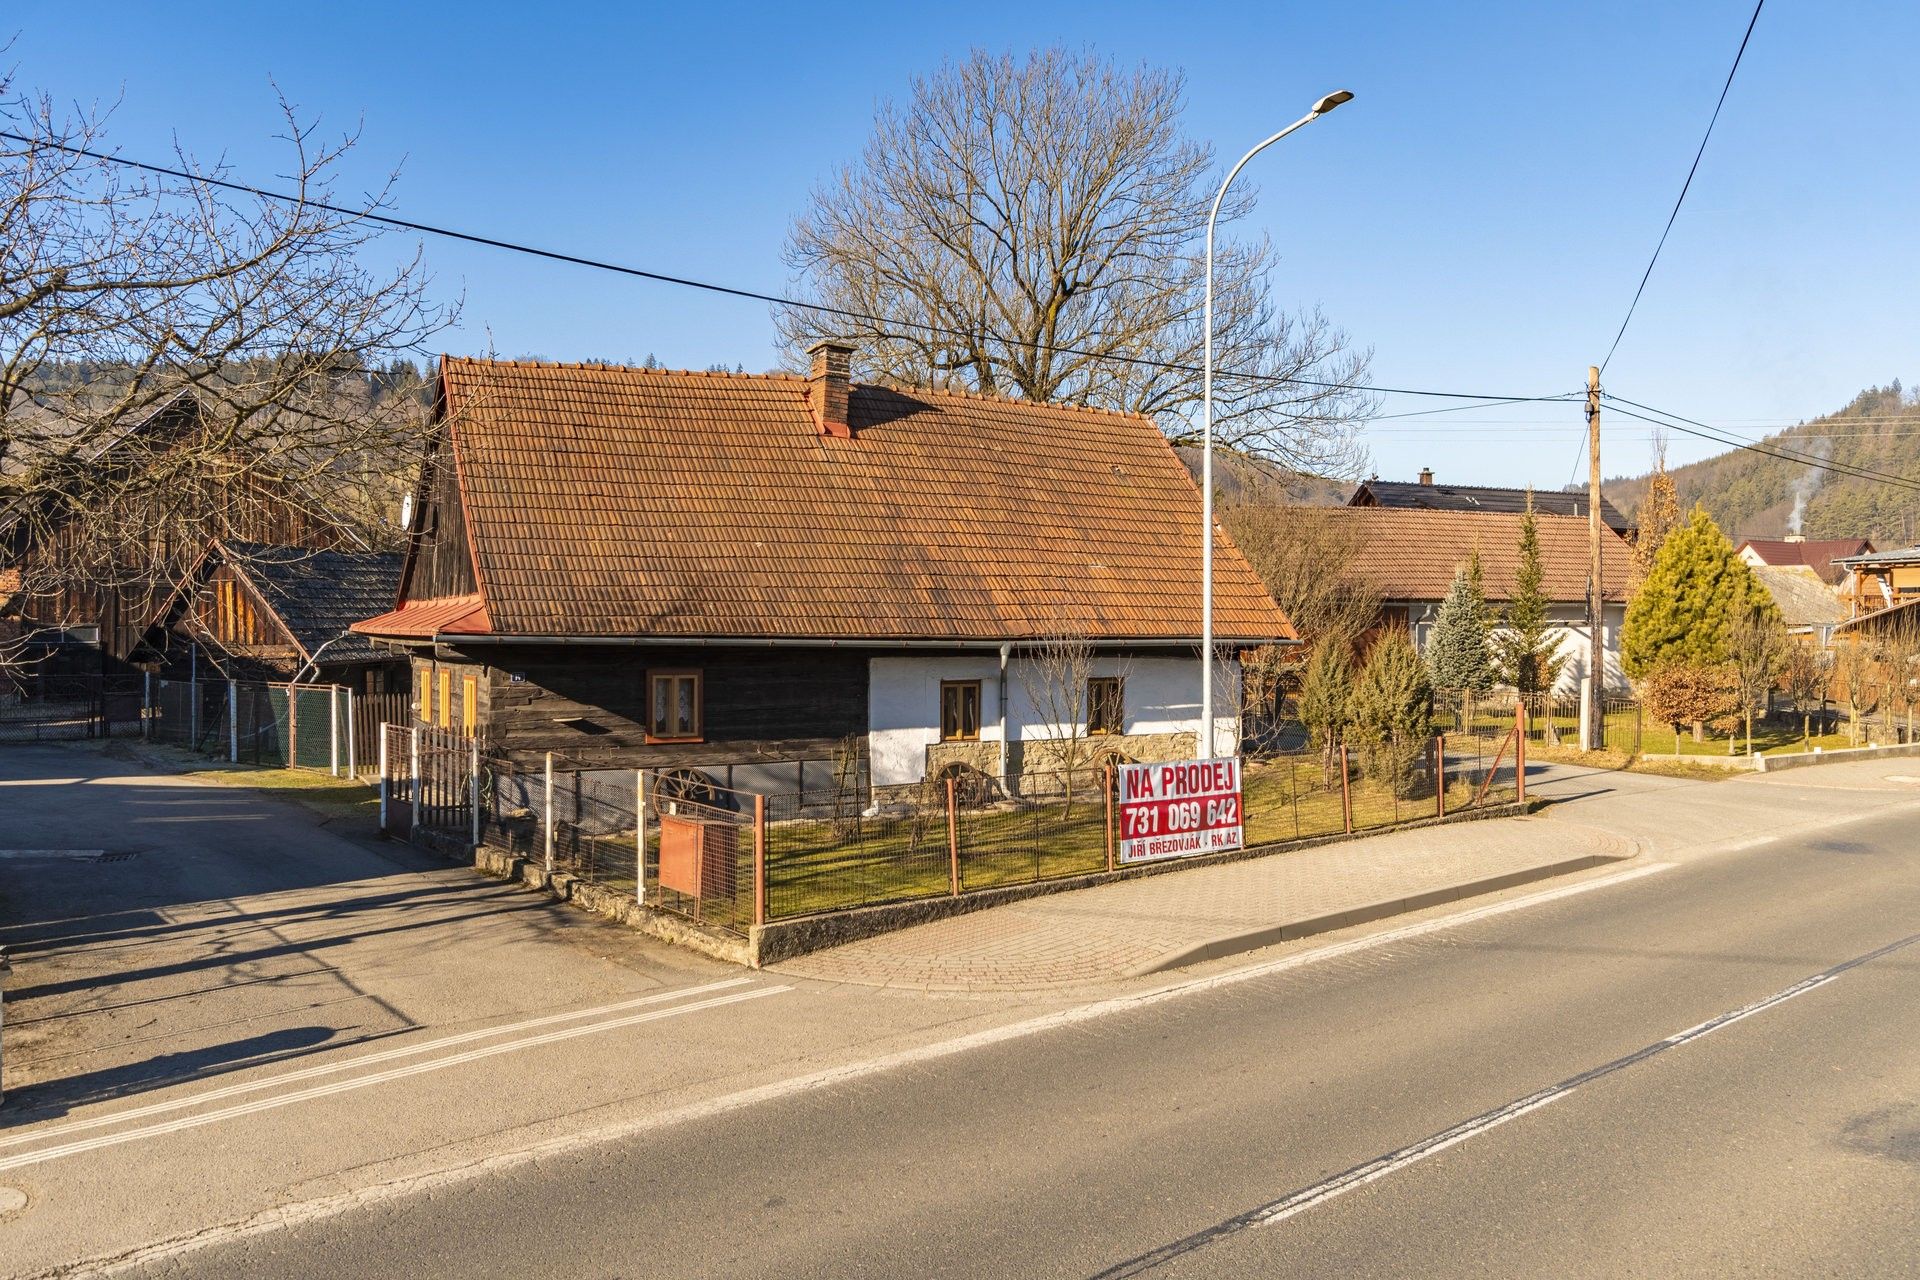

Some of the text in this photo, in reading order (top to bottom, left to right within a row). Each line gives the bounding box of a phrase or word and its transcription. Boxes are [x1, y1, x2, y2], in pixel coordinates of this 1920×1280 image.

[1126, 762, 1234, 799] NA PRODEJ
[1126, 798, 1237, 835] 731 069 642
[1128, 840, 1147, 858] JIŘÍ
[1150, 834, 1201, 855] BŘEZOVJÁK
[1211, 834, 1223, 847] RK
[1226, 832, 1237, 845] AZ
